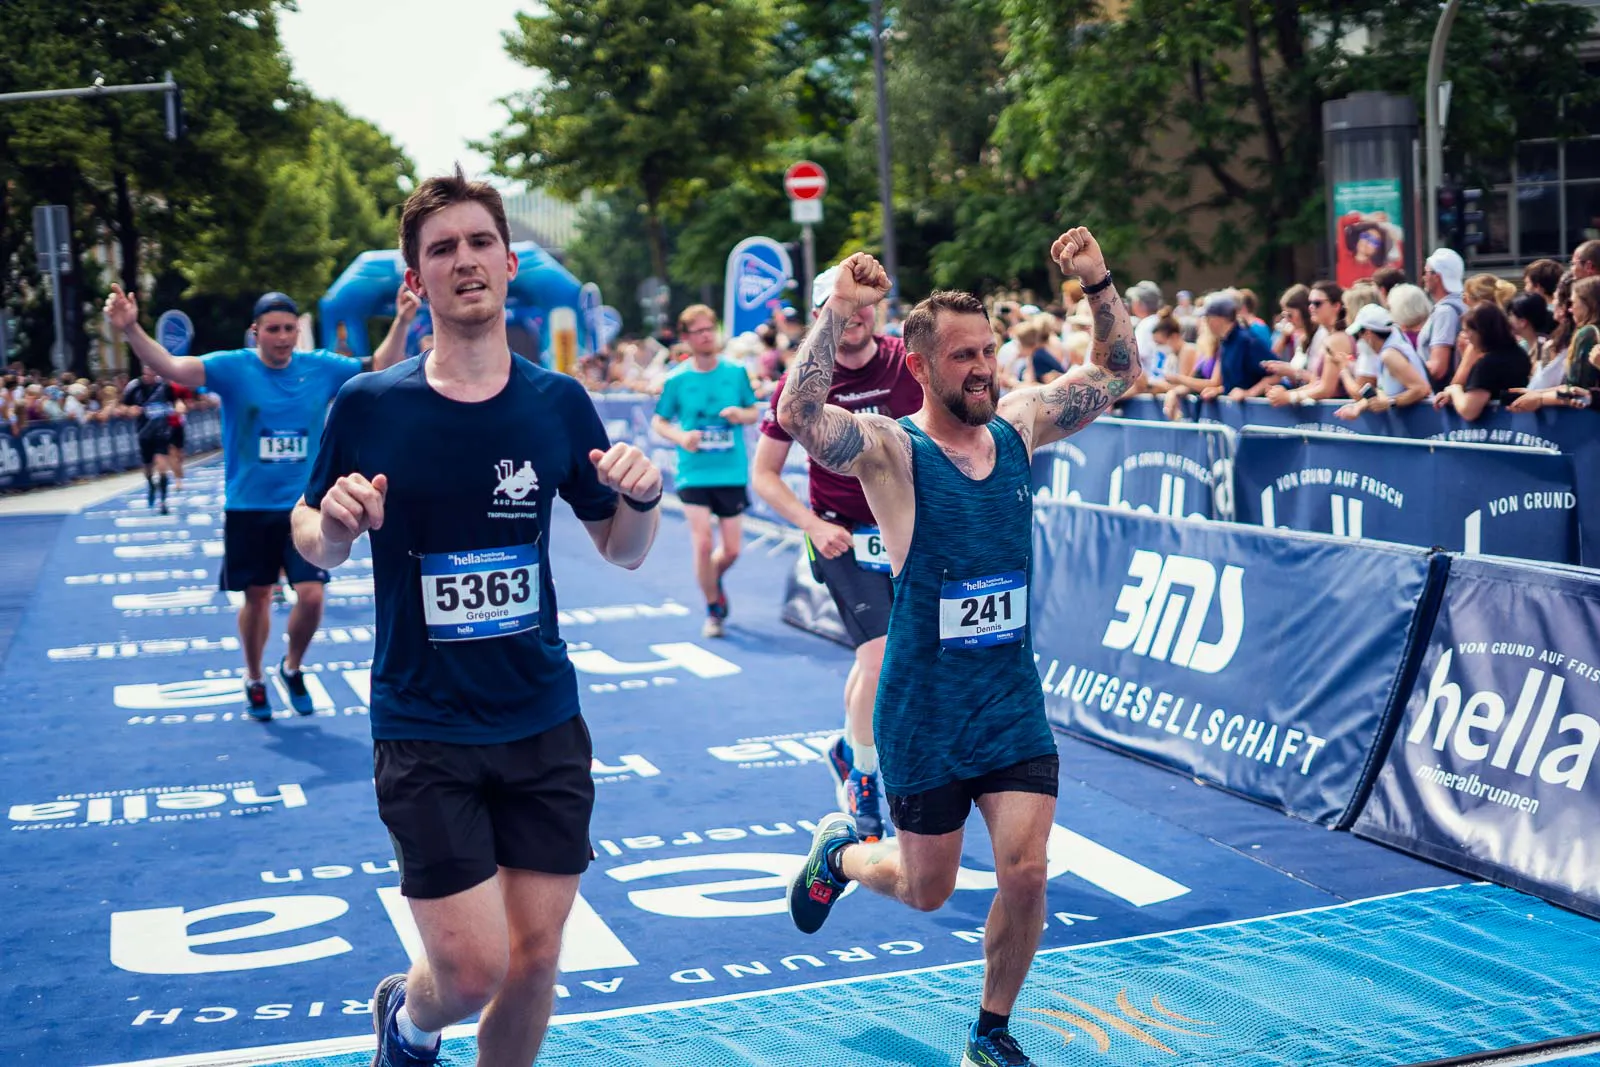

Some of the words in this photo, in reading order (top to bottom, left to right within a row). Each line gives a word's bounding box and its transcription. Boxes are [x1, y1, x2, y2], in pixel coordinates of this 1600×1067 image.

[267, 438, 303, 452] 1341
[1276, 472, 1299, 492] VON
[1300, 468, 1332, 486] GRUND
[1334, 470, 1359, 488] AUF
[1360, 475, 1404, 509] FRISCH
[1489, 496, 1518, 517] VON
[1524, 492, 1576, 511] GRUND
[454, 553, 480, 566] hella
[435, 568, 531, 612] 5363
[966, 580, 987, 591] hella
[466, 609, 509, 620] Grégoire
[960, 591, 1011, 627] 241
[457, 626, 474, 634] hella
[976, 624, 1002, 634] Dennis
[1459, 642, 1486, 654] VON
[1491, 642, 1535, 658] GRUND
[1539, 650, 1565, 666] AUF
[1567, 658, 1600, 683] FRIS
[1042, 659, 1327, 775] LAUFGESELLSCHAFT
[1407, 648, 1600, 791] hella
[8, 784, 307, 822] hella
[1416, 764, 1540, 814] mineralbrunnen
[670, 940, 924, 984] GRUND
[131, 998, 374, 1026] RISCH
